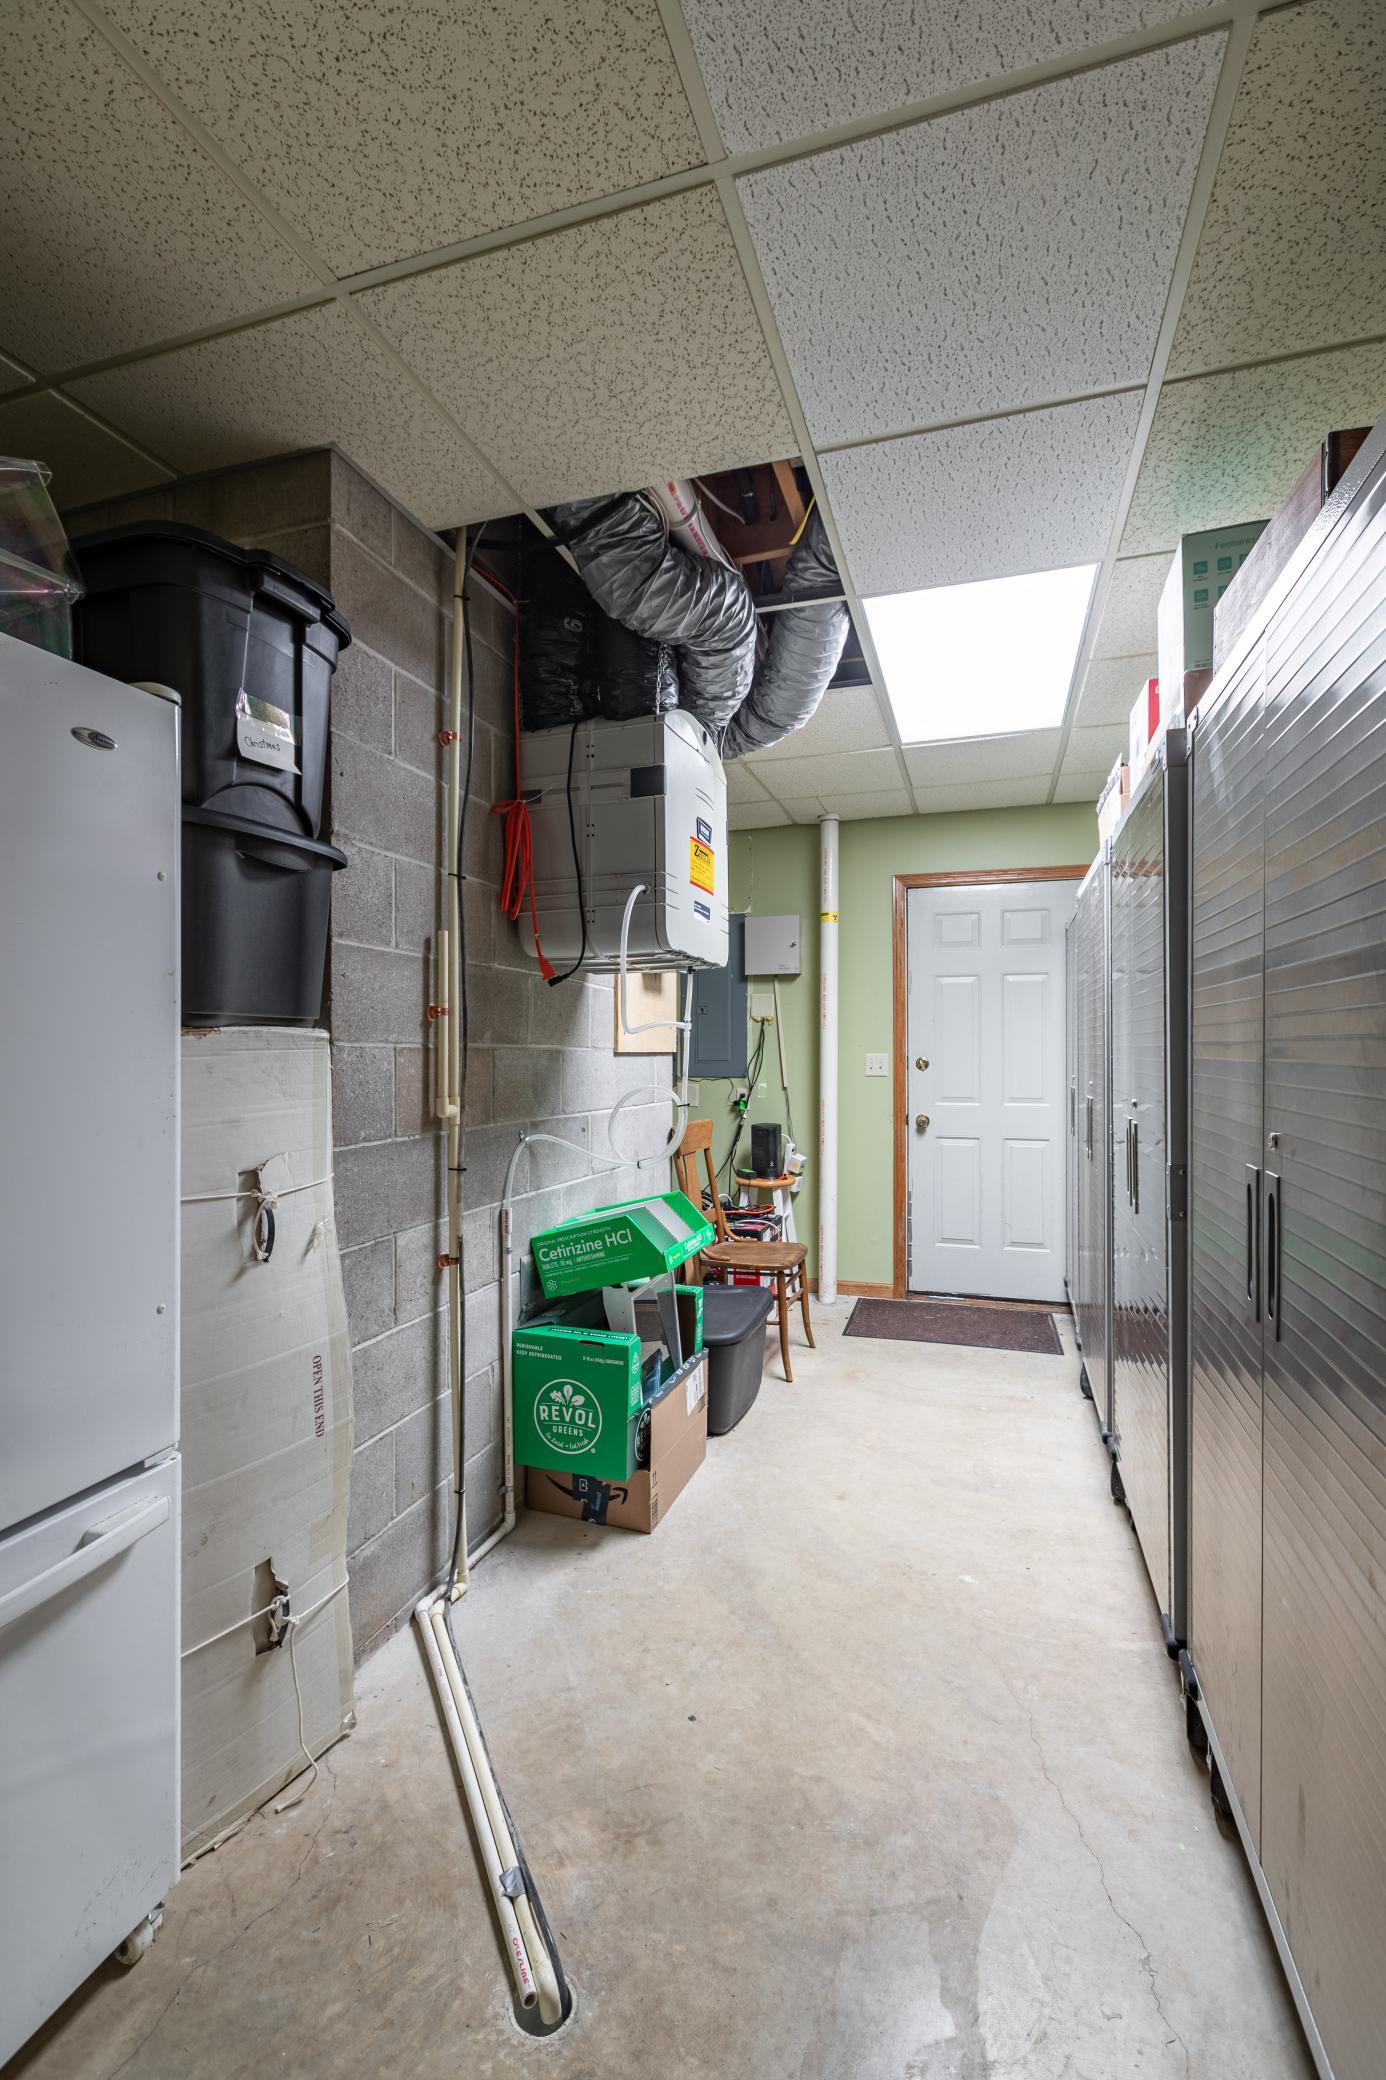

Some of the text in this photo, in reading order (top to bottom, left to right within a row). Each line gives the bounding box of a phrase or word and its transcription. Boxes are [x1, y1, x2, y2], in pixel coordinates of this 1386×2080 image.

[243, 736, 281, 752] Christmas
[538, 1228, 633, 1262] Cetirizine HCl
[312, 1355, 325, 1438] OPEN THIS END
[539, 1404, 596, 1429] REVOL
[552, 1425, 584, 1437] GREENS
